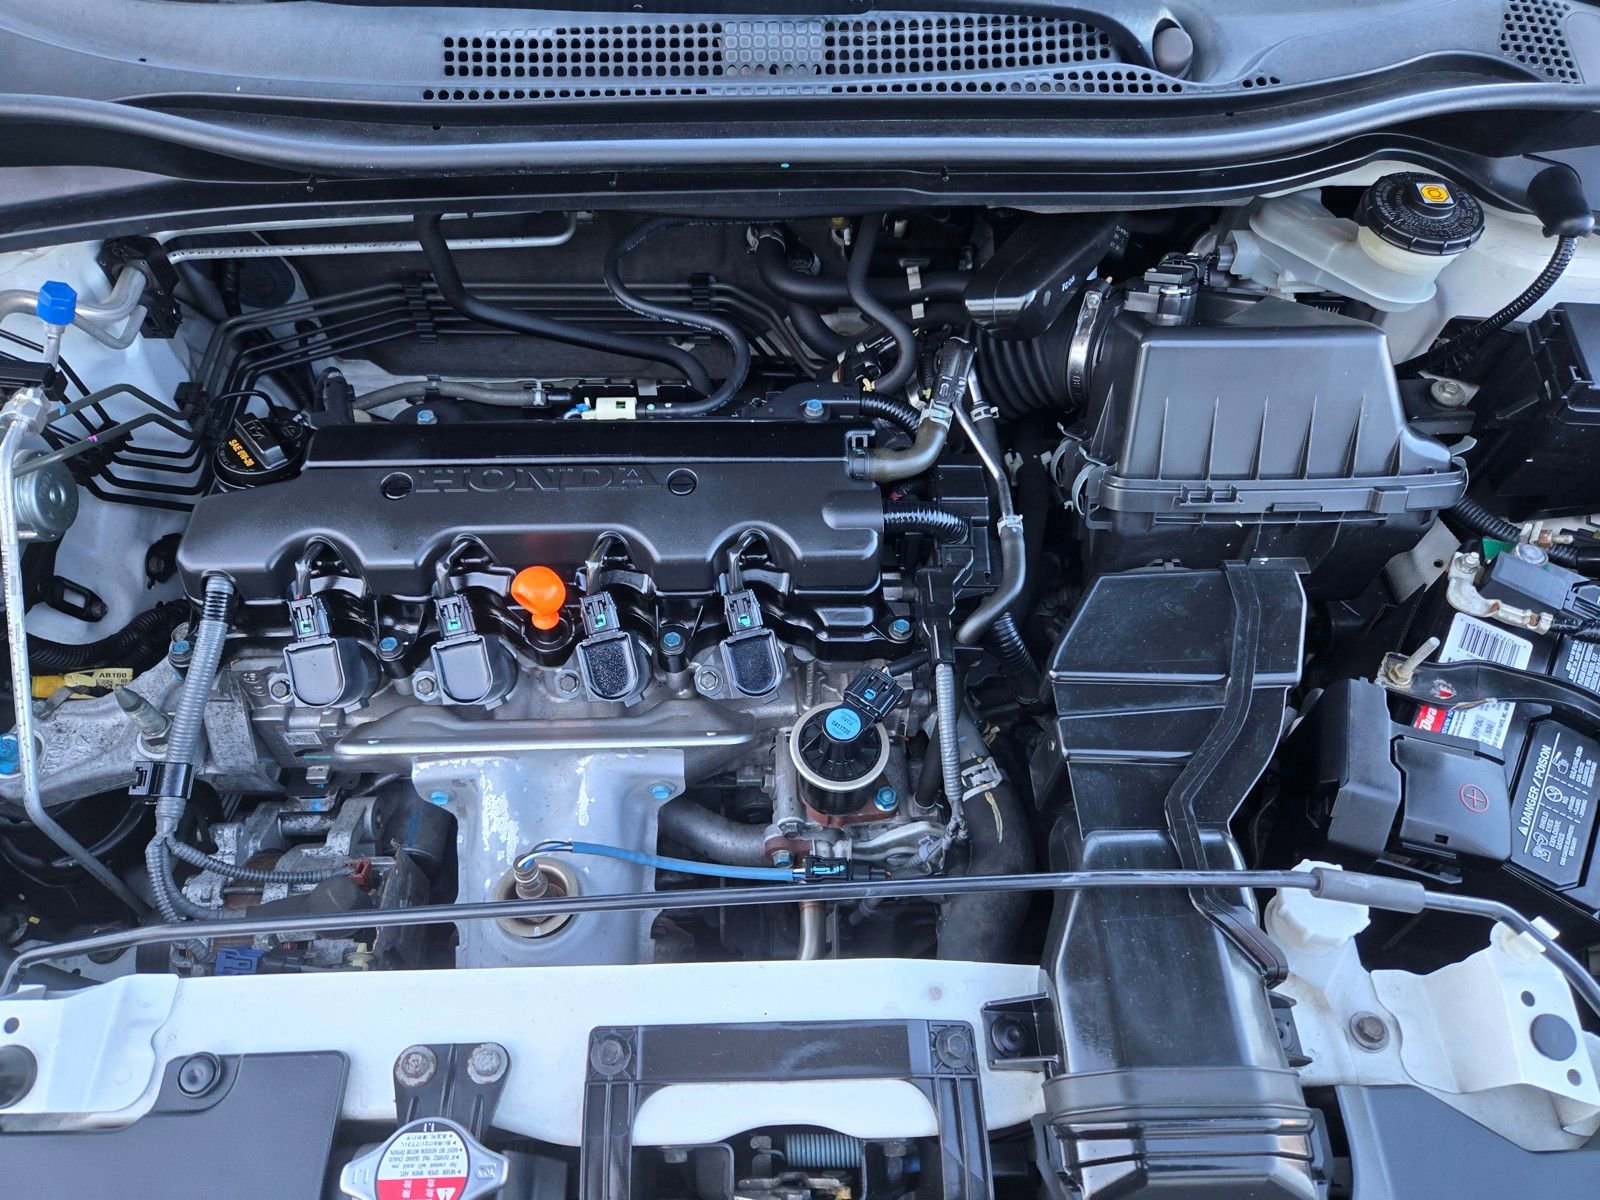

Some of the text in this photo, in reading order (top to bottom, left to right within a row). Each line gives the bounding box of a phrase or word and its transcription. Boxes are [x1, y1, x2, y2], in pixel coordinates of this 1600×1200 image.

[228, 439, 242, 452] SAE
[416, 466, 662, 493] HONDA
[1419, 707, 1437, 730] Dura
[1521, 786, 1538, 826] DANGER
[1534, 745, 1551, 779] POISON
[1539, 811, 1548, 830] SHIELD
[1545, 818, 1554, 833] EYES
[1549, 820, 1561, 848] EXPLOSIVE
[1556, 832, 1565, 850] GASES
[423, 1123, 435, 1132] 1.1
